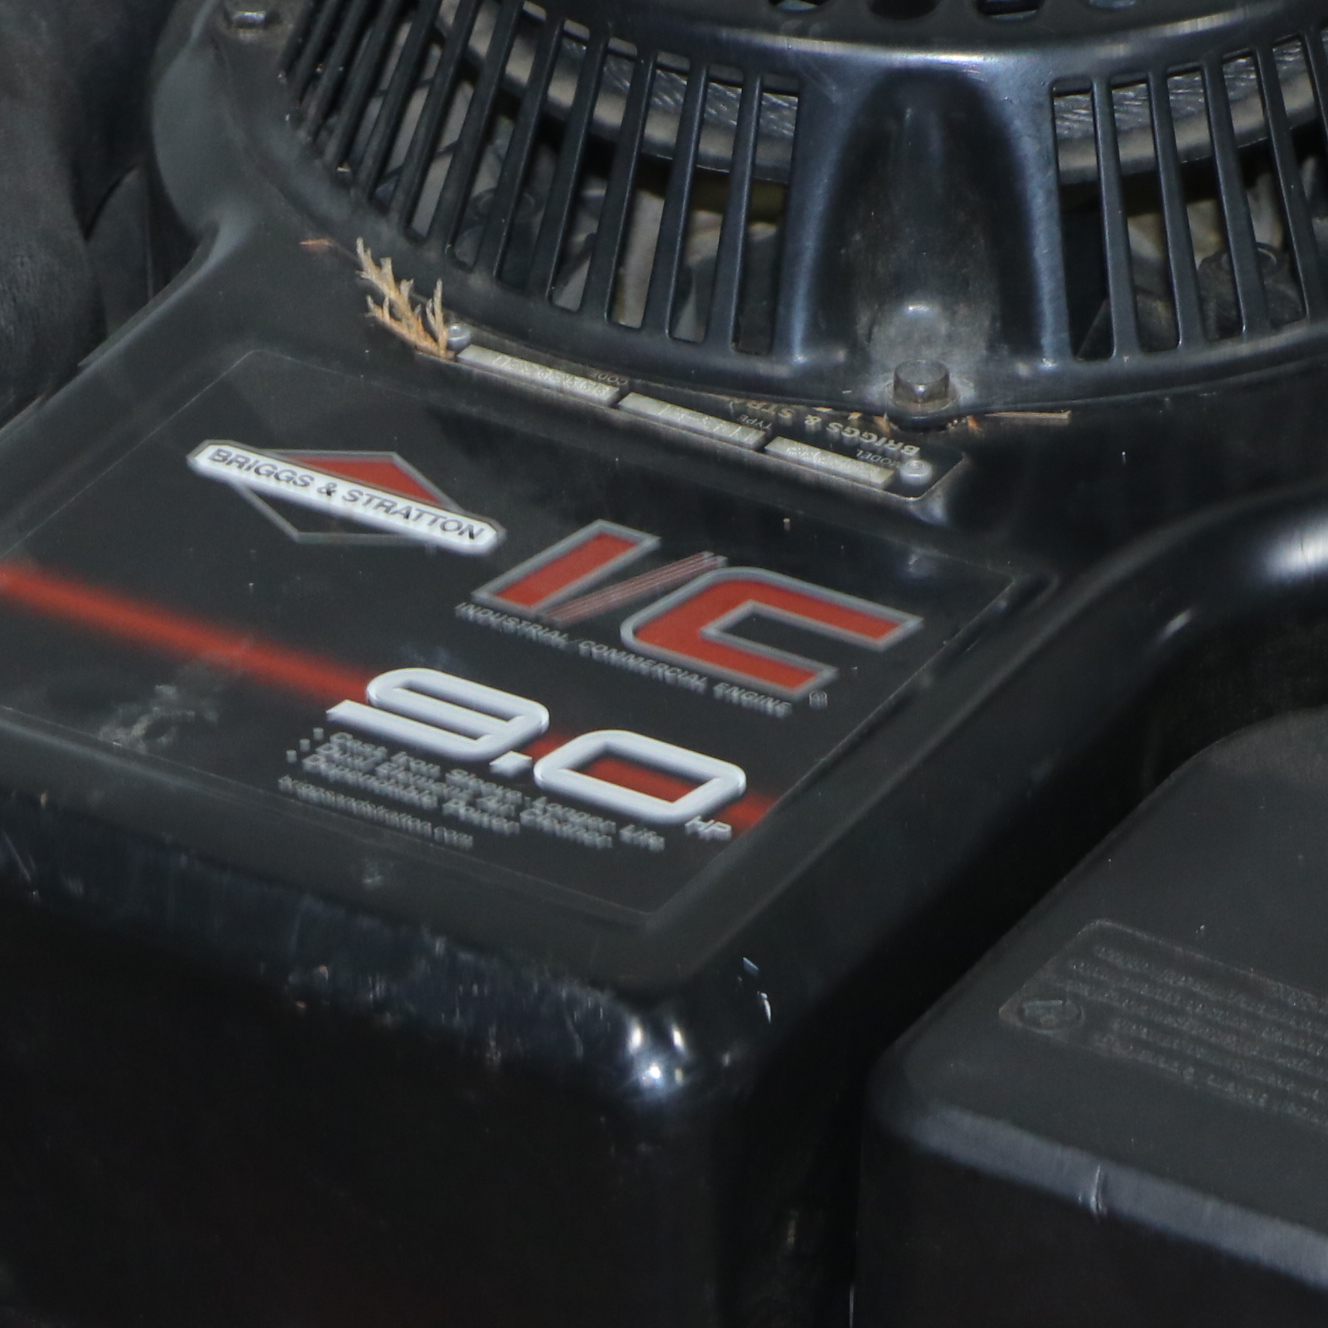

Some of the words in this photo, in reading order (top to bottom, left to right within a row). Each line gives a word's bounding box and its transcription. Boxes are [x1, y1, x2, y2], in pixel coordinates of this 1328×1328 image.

[739, 414, 773, 429] TYPE
[804, 413, 822, 427] &
[826, 421, 921, 456] BRIGGS
[207, 447, 315, 488] BRIGGS
[317, 481, 338, 497] &
[341, 488, 485, 541] STRATTON
[712, 681, 792, 718] ENGINE
[326, 667, 746, 825] 9.0
[684, 815, 733, 841] HP
